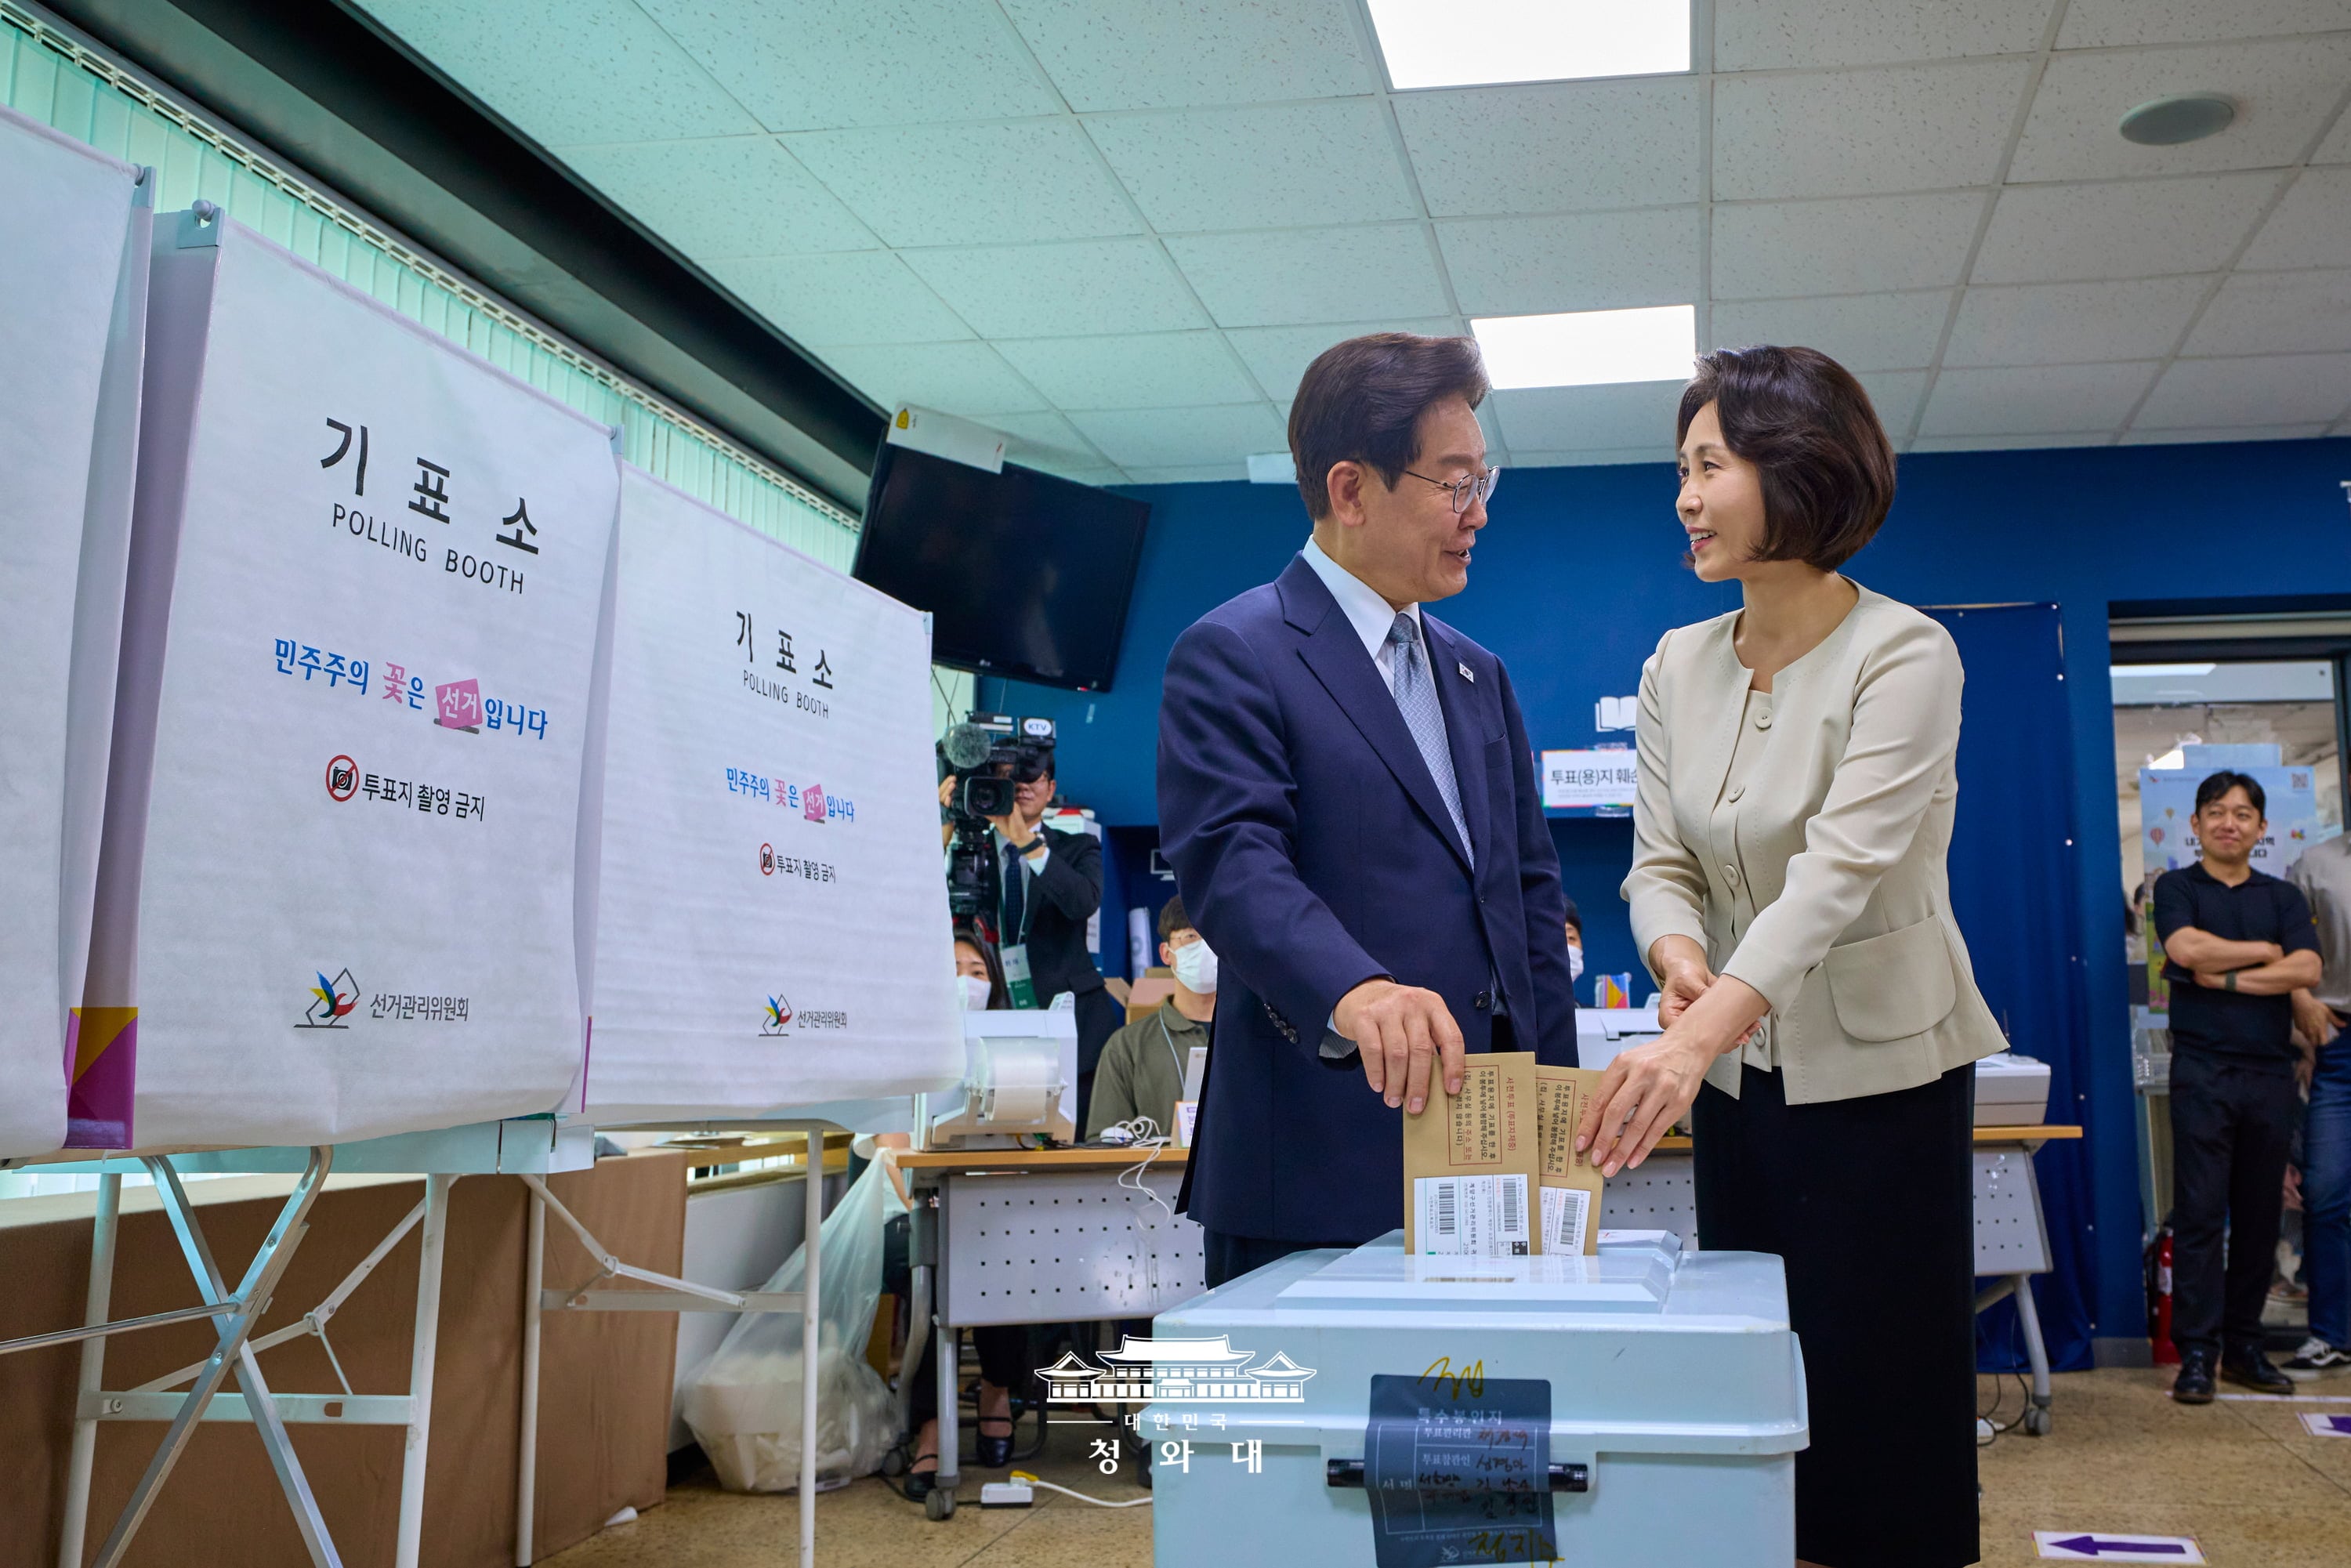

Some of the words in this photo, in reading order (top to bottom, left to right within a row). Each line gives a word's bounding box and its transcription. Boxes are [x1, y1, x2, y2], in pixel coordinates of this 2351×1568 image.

[321, 417, 539, 555] 기표소
[332, 502, 427, 562] POLLING
[445, 549, 524, 594] BOOTH
[737, 610, 833, 690] 기표소
[275, 639, 369, 695] 민주주의
[382, 661, 426, 710] 꽃은
[441, 685, 549, 741] 선거입니다
[744, 669, 788, 704] POLLING
[796, 691, 829, 719] BOOTH
[362, 773, 412, 808] 투표지
[417, 784, 451, 816] 촬영
[455, 792, 485, 822] 금지
[726, 767, 770, 802] 민주주의
[774, 778, 799, 808] 꽃은
[806, 791, 855, 823] 선거입니다
[1550, 768, 1613, 787] 투표(용)지
[777, 855, 802, 878] 투표지
[803, 860, 820, 881] 촬영
[821, 864, 836, 884] 금지
[370, 993, 469, 1022] 선거관리위원회
[797, 1010, 847, 1029] 선거관리위원회
[1465, 1129, 1472, 1143] 주소
[1465, 1147, 1473, 1160] 또는
